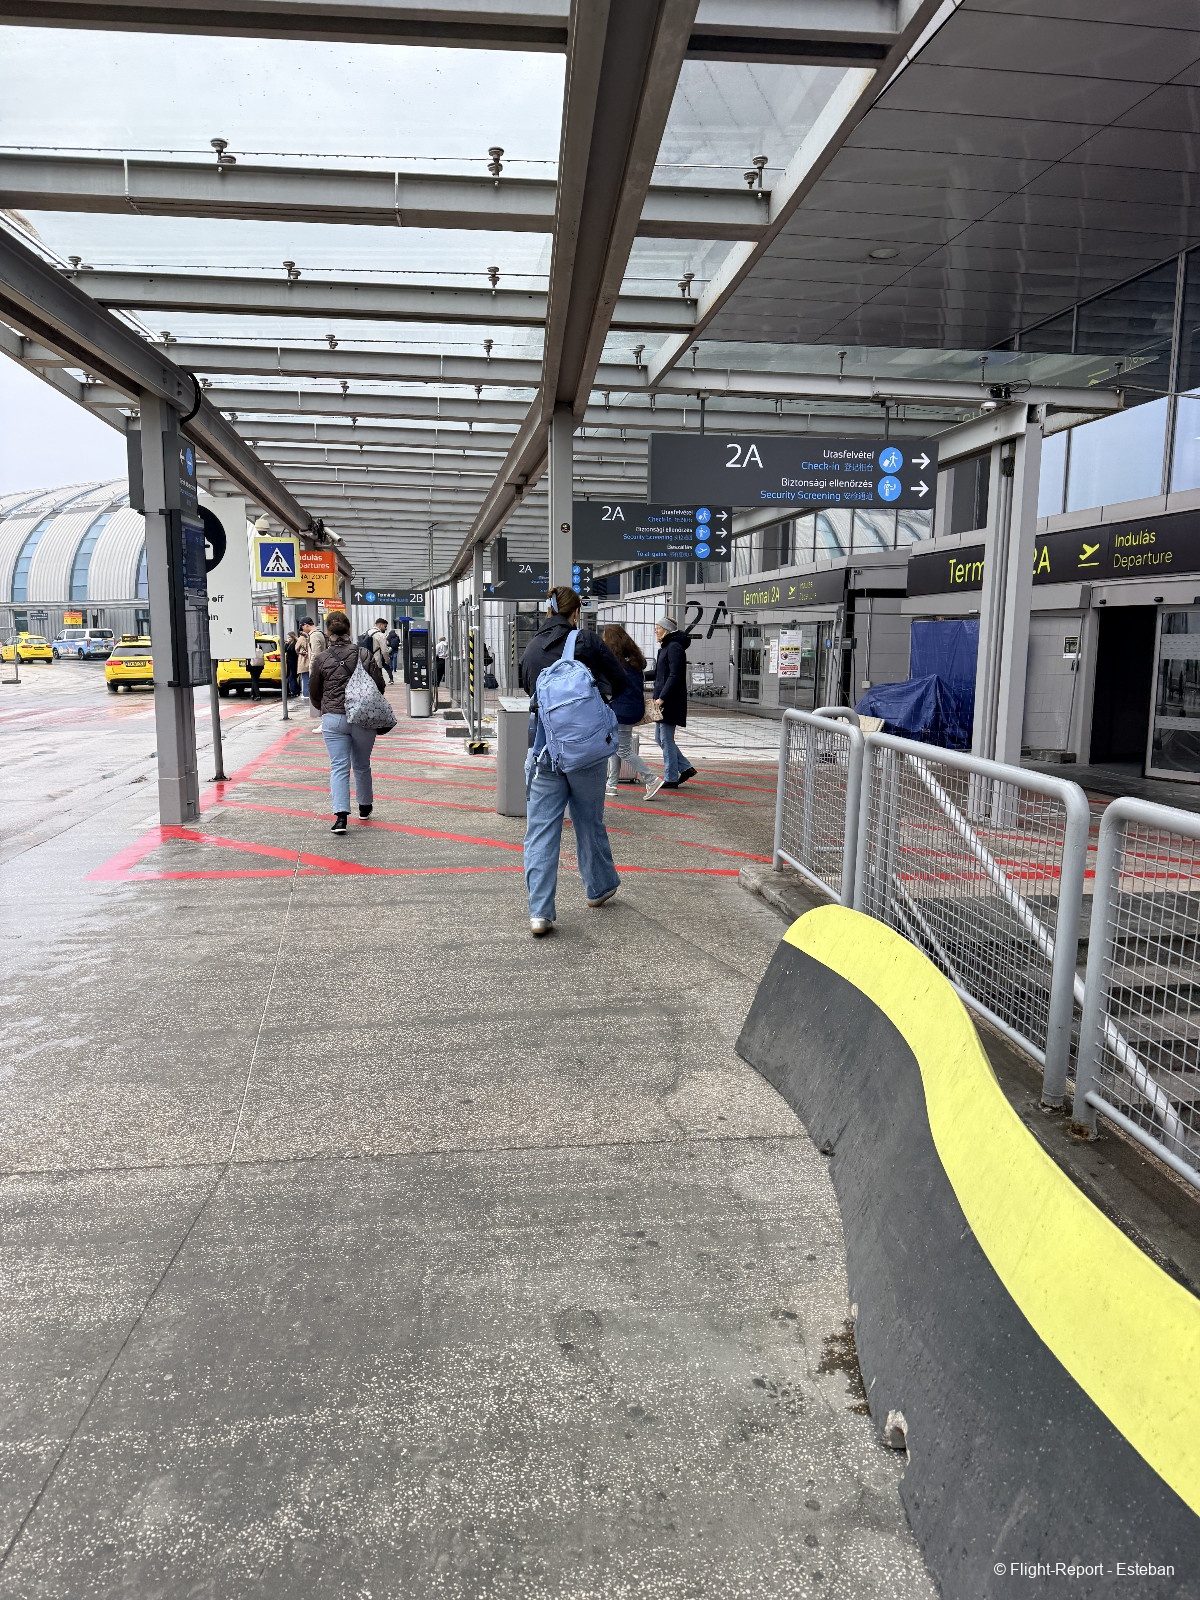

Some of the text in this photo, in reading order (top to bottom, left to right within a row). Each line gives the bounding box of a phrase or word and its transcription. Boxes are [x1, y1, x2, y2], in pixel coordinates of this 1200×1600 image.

[725, 443, 764, 468] 2A
[823, 449, 875, 459] Utasfelvétel
[801, 461, 840, 471] Check-in
[781, 477, 873, 489] Biztonsági ellenőrzés
[760, 490, 796, 501] Security
[797, 490, 841, 502] Screening
[601, 505, 626, 521] 2A
[1115, 528, 1156, 547] Indulás
[300, 553, 323, 561] dulás
[1113, 551, 1173, 570] Departure
[300, 562, 330, 570] partures
[518, 564, 533, 573] 2A
[949, 558, 985, 584] Term
[306, 580, 315, 594] 3
[409, 593, 424, 603] 2B
[743, 587, 770, 606] Terminal
[771, 586, 780, 603] 2A
[208, 613, 219, 621] in
